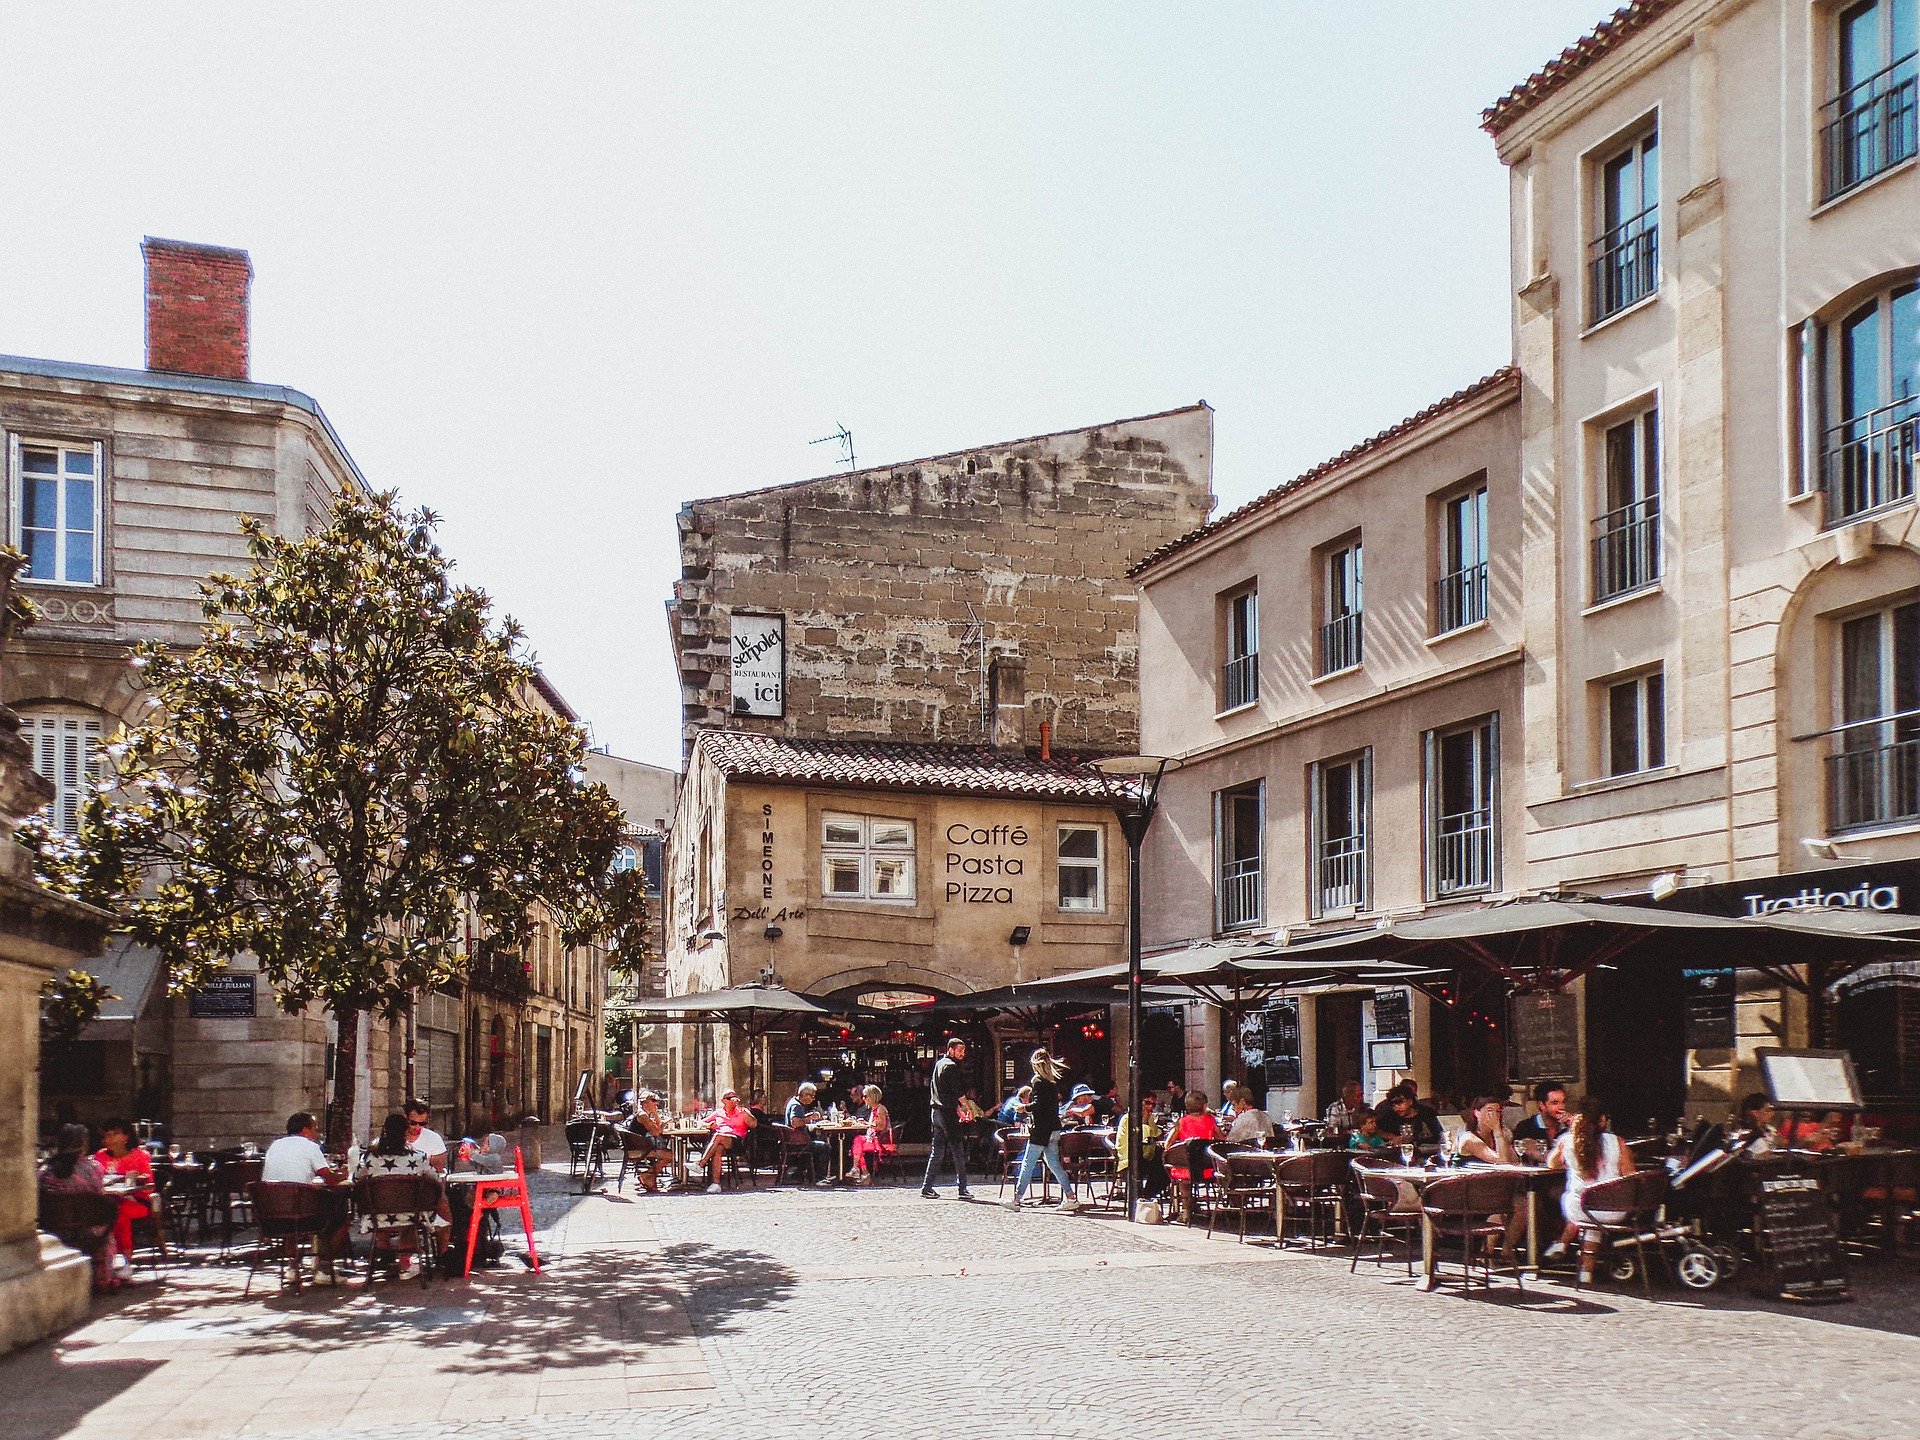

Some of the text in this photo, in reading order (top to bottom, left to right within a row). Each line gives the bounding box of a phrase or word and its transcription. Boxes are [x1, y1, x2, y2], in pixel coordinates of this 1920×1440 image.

[732, 628, 782, 669] serpolet
[733, 634, 751, 651] le
[734, 670, 781, 679] RESTAURANT
[754, 682, 782, 702] ici
[946, 823, 1028, 846] Caffé
[762, 804, 774, 899] SIMEONE
[946, 852, 1023, 875] Pasta
[946, 882, 1013, 903] Pizza
[1743, 881, 1899, 916] Trattoria
[733, 906, 804, 922] Dell' Arte
